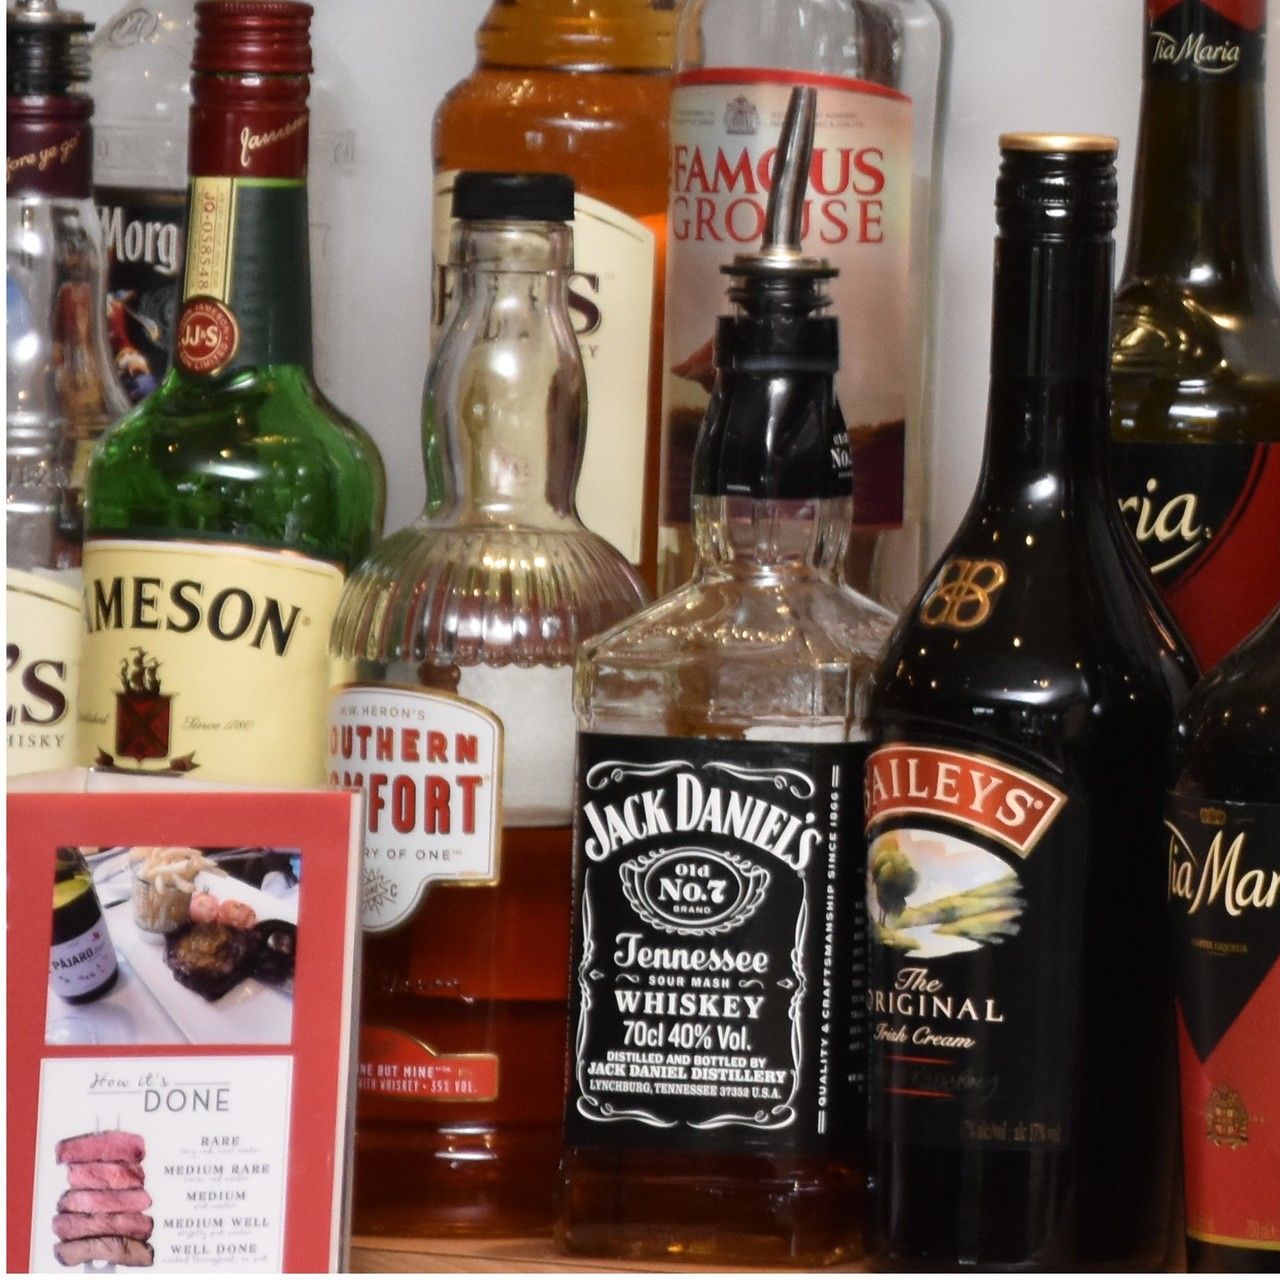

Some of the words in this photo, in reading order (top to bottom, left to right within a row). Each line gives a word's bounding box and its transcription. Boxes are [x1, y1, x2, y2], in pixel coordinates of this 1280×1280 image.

[1152, 31, 1178, 64] Tia
[1175, 32, 1241, 66] Maria
[362, 705, 426, 721] HERON'S
[582, 787, 673, 863] JACK
[675, 772, 823, 872] DANIEL'S
[387, 849, 407, 860] OF
[416, 850, 450, 860] ONE
[827, 831, 838, 881] SINCE
[1164, 819, 1200, 902] Tia
[675, 863, 710, 878] Old
[657, 877, 727, 904] No.7
[673, 904, 712, 916] BRAND
[612, 931, 769, 974] Tennessee
[821, 885, 837, 1020] CRAFTSMANSHIP
[648, 974, 685, 987] SOUR
[690, 976, 731, 989] MASH
[894, 967, 944, 994] The
[614, 989, 765, 1020] WHISKEY
[622, 1019, 664, 1048] 70cl
[667, 1021, 713, 1050] 40%
[717, 1024, 752, 1052] Vol.
[873, 1023, 906, 1044] Irish
[912, 1025, 976, 1050] Cream
[606, 1051, 664, 1065] DISTILLED
[666, 1053, 691, 1066] AND
[694, 1055, 747, 1068] BOTTLED
[750, 1057, 767, 1069] BY
[90, 1072, 129, 1089] How
[587, 1061, 627, 1077] JACK
[629, 1063, 688, 1080] DANIEL
[691, 1067, 787, 1084] DISTILLERY
[817, 1039, 831, 1107] QUALITY
[589, 1078, 653, 1095] LYNCHBURG,
[654, 1082, 718, 1096] TENNESSEE
[720, 1085, 749, 1098] 37352
[752, 1086, 782, 1099] U.S.A.
[143, 1088, 230, 1113] DONE
[201, 1135, 240, 1146] RARE
[163, 1164, 224, 1176] MEDIUM
[231, 1163, 270, 1175] RARE
[186, 1190, 246, 1201] MEDIUM
[162, 1217, 224, 1229] MEDIUM
[231, 1217, 270, 1228] WELL
[170, 1244, 210, 1256] WELL
[216, 1243, 258, 1255] DONE
